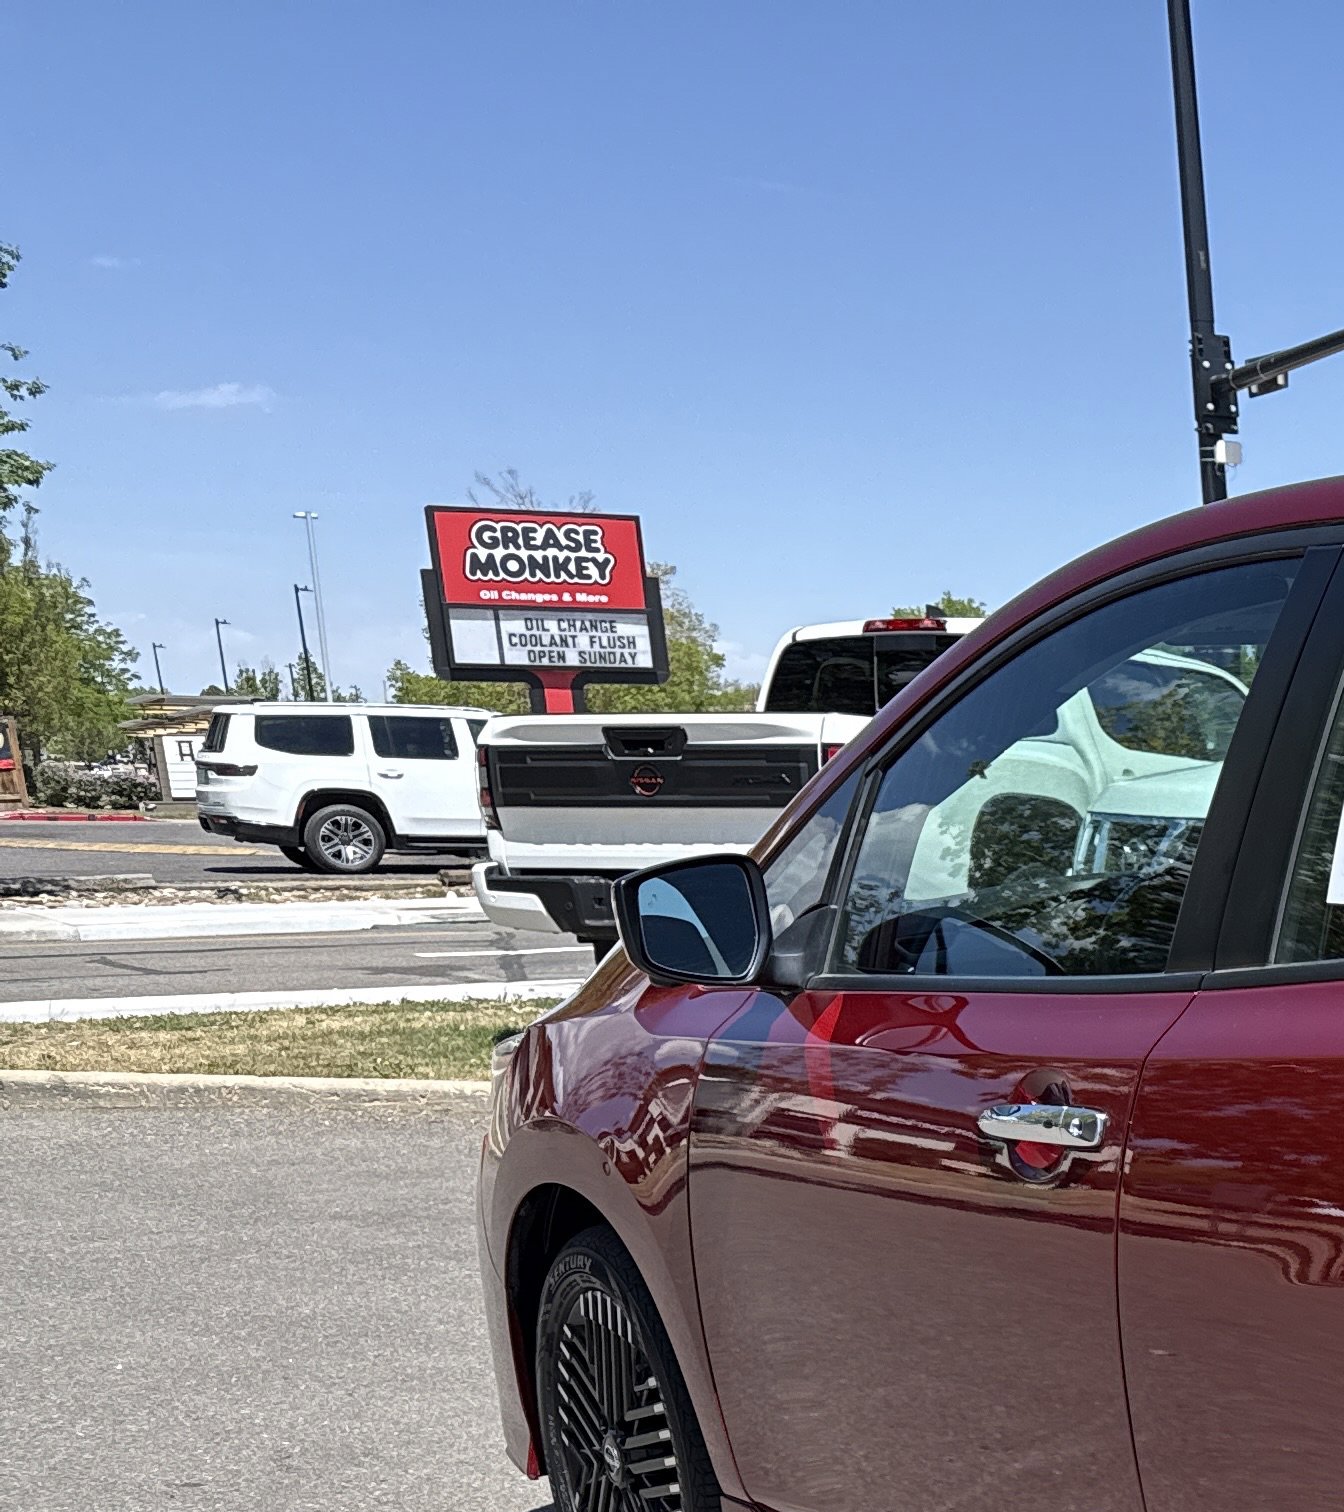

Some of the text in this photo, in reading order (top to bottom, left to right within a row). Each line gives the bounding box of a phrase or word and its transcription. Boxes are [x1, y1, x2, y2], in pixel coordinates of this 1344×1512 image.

[474, 523, 602, 553] GREASE
[468, 552, 613, 581] MONKEY
[479, 589, 609, 603] Oil Changes & More
[524, 618, 618, 633] OIL CHANGE
[508, 633, 637, 650] COOLANT FLUSH
[528, 650, 638, 665] OPEN SUNDAY
[548, 1254, 592, 1290] SENTURY
